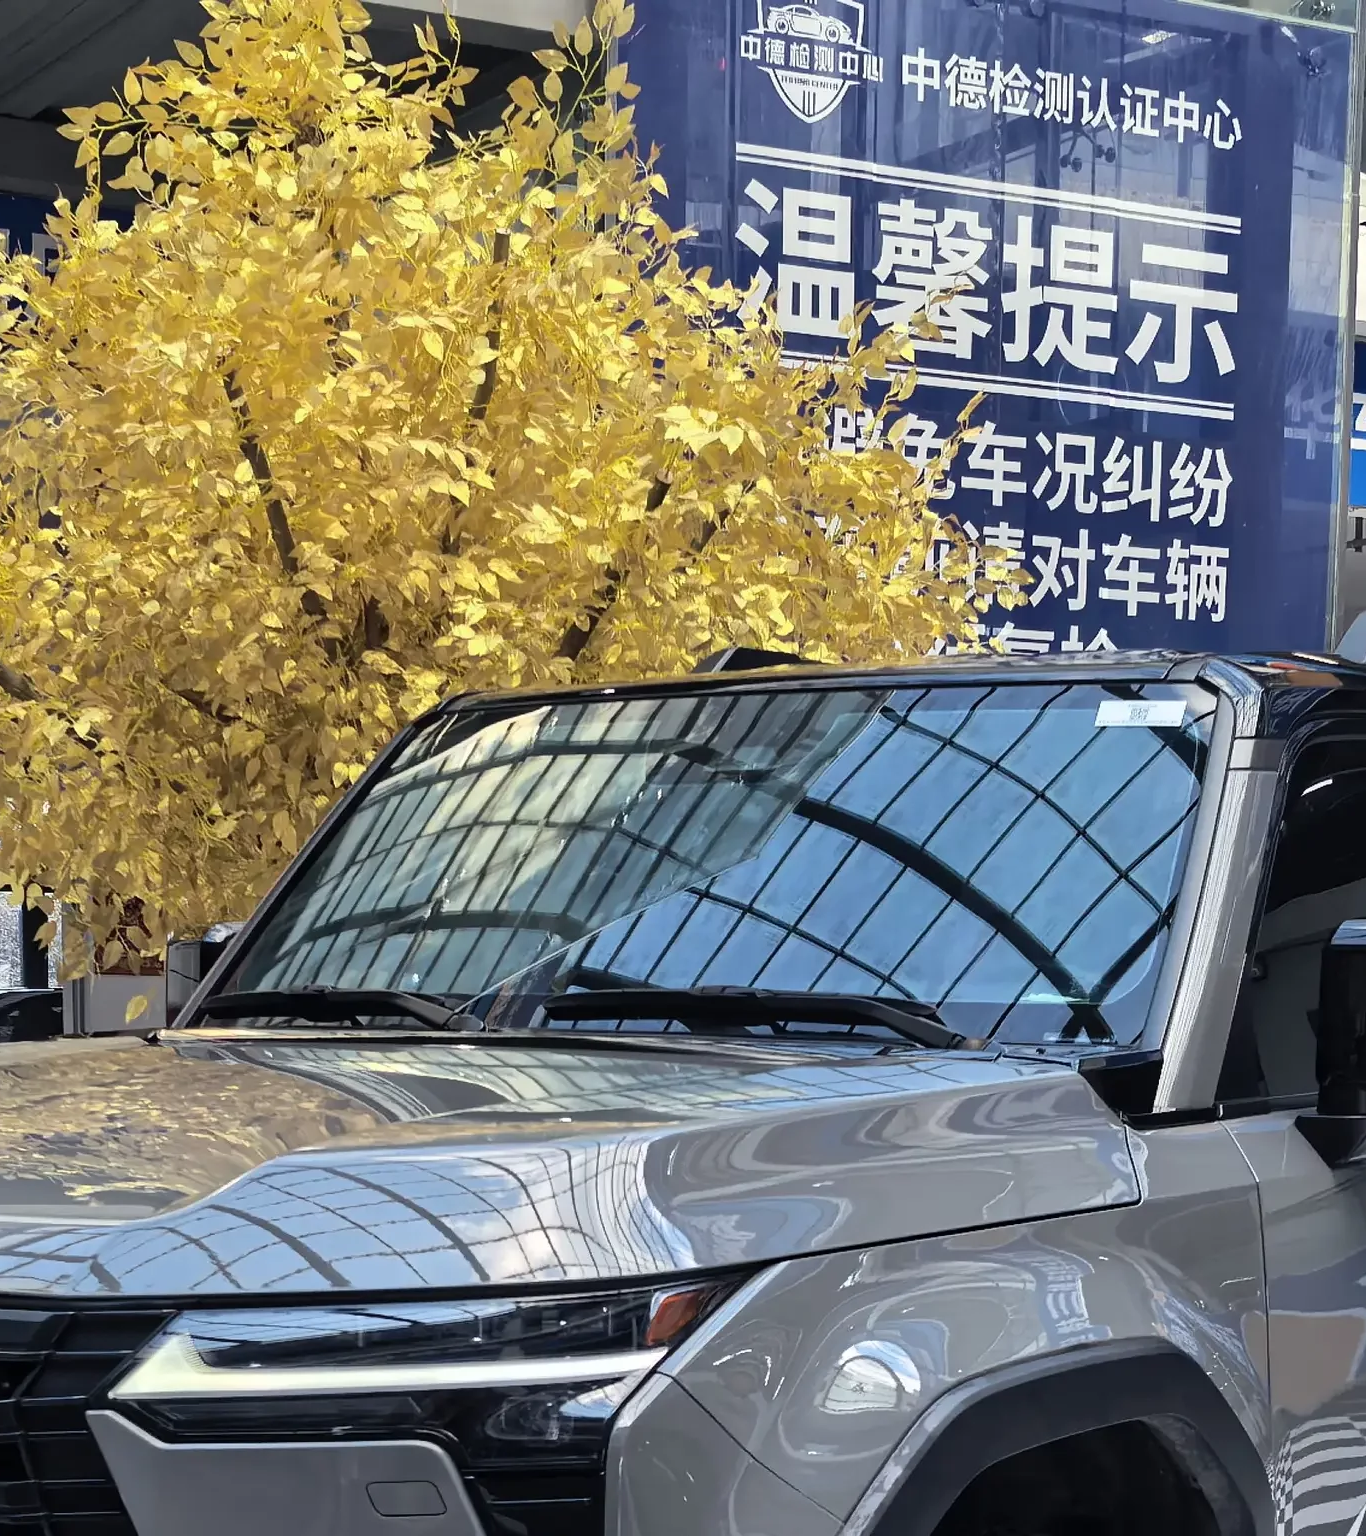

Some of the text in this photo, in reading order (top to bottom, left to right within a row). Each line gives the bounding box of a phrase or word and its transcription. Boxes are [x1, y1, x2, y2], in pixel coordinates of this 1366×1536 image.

[740, 34, 884, 83] 中德检测中心
[900, 48, 1243, 151] 中德检测认证中心
[735, 178, 1239, 386] 温馨提示
